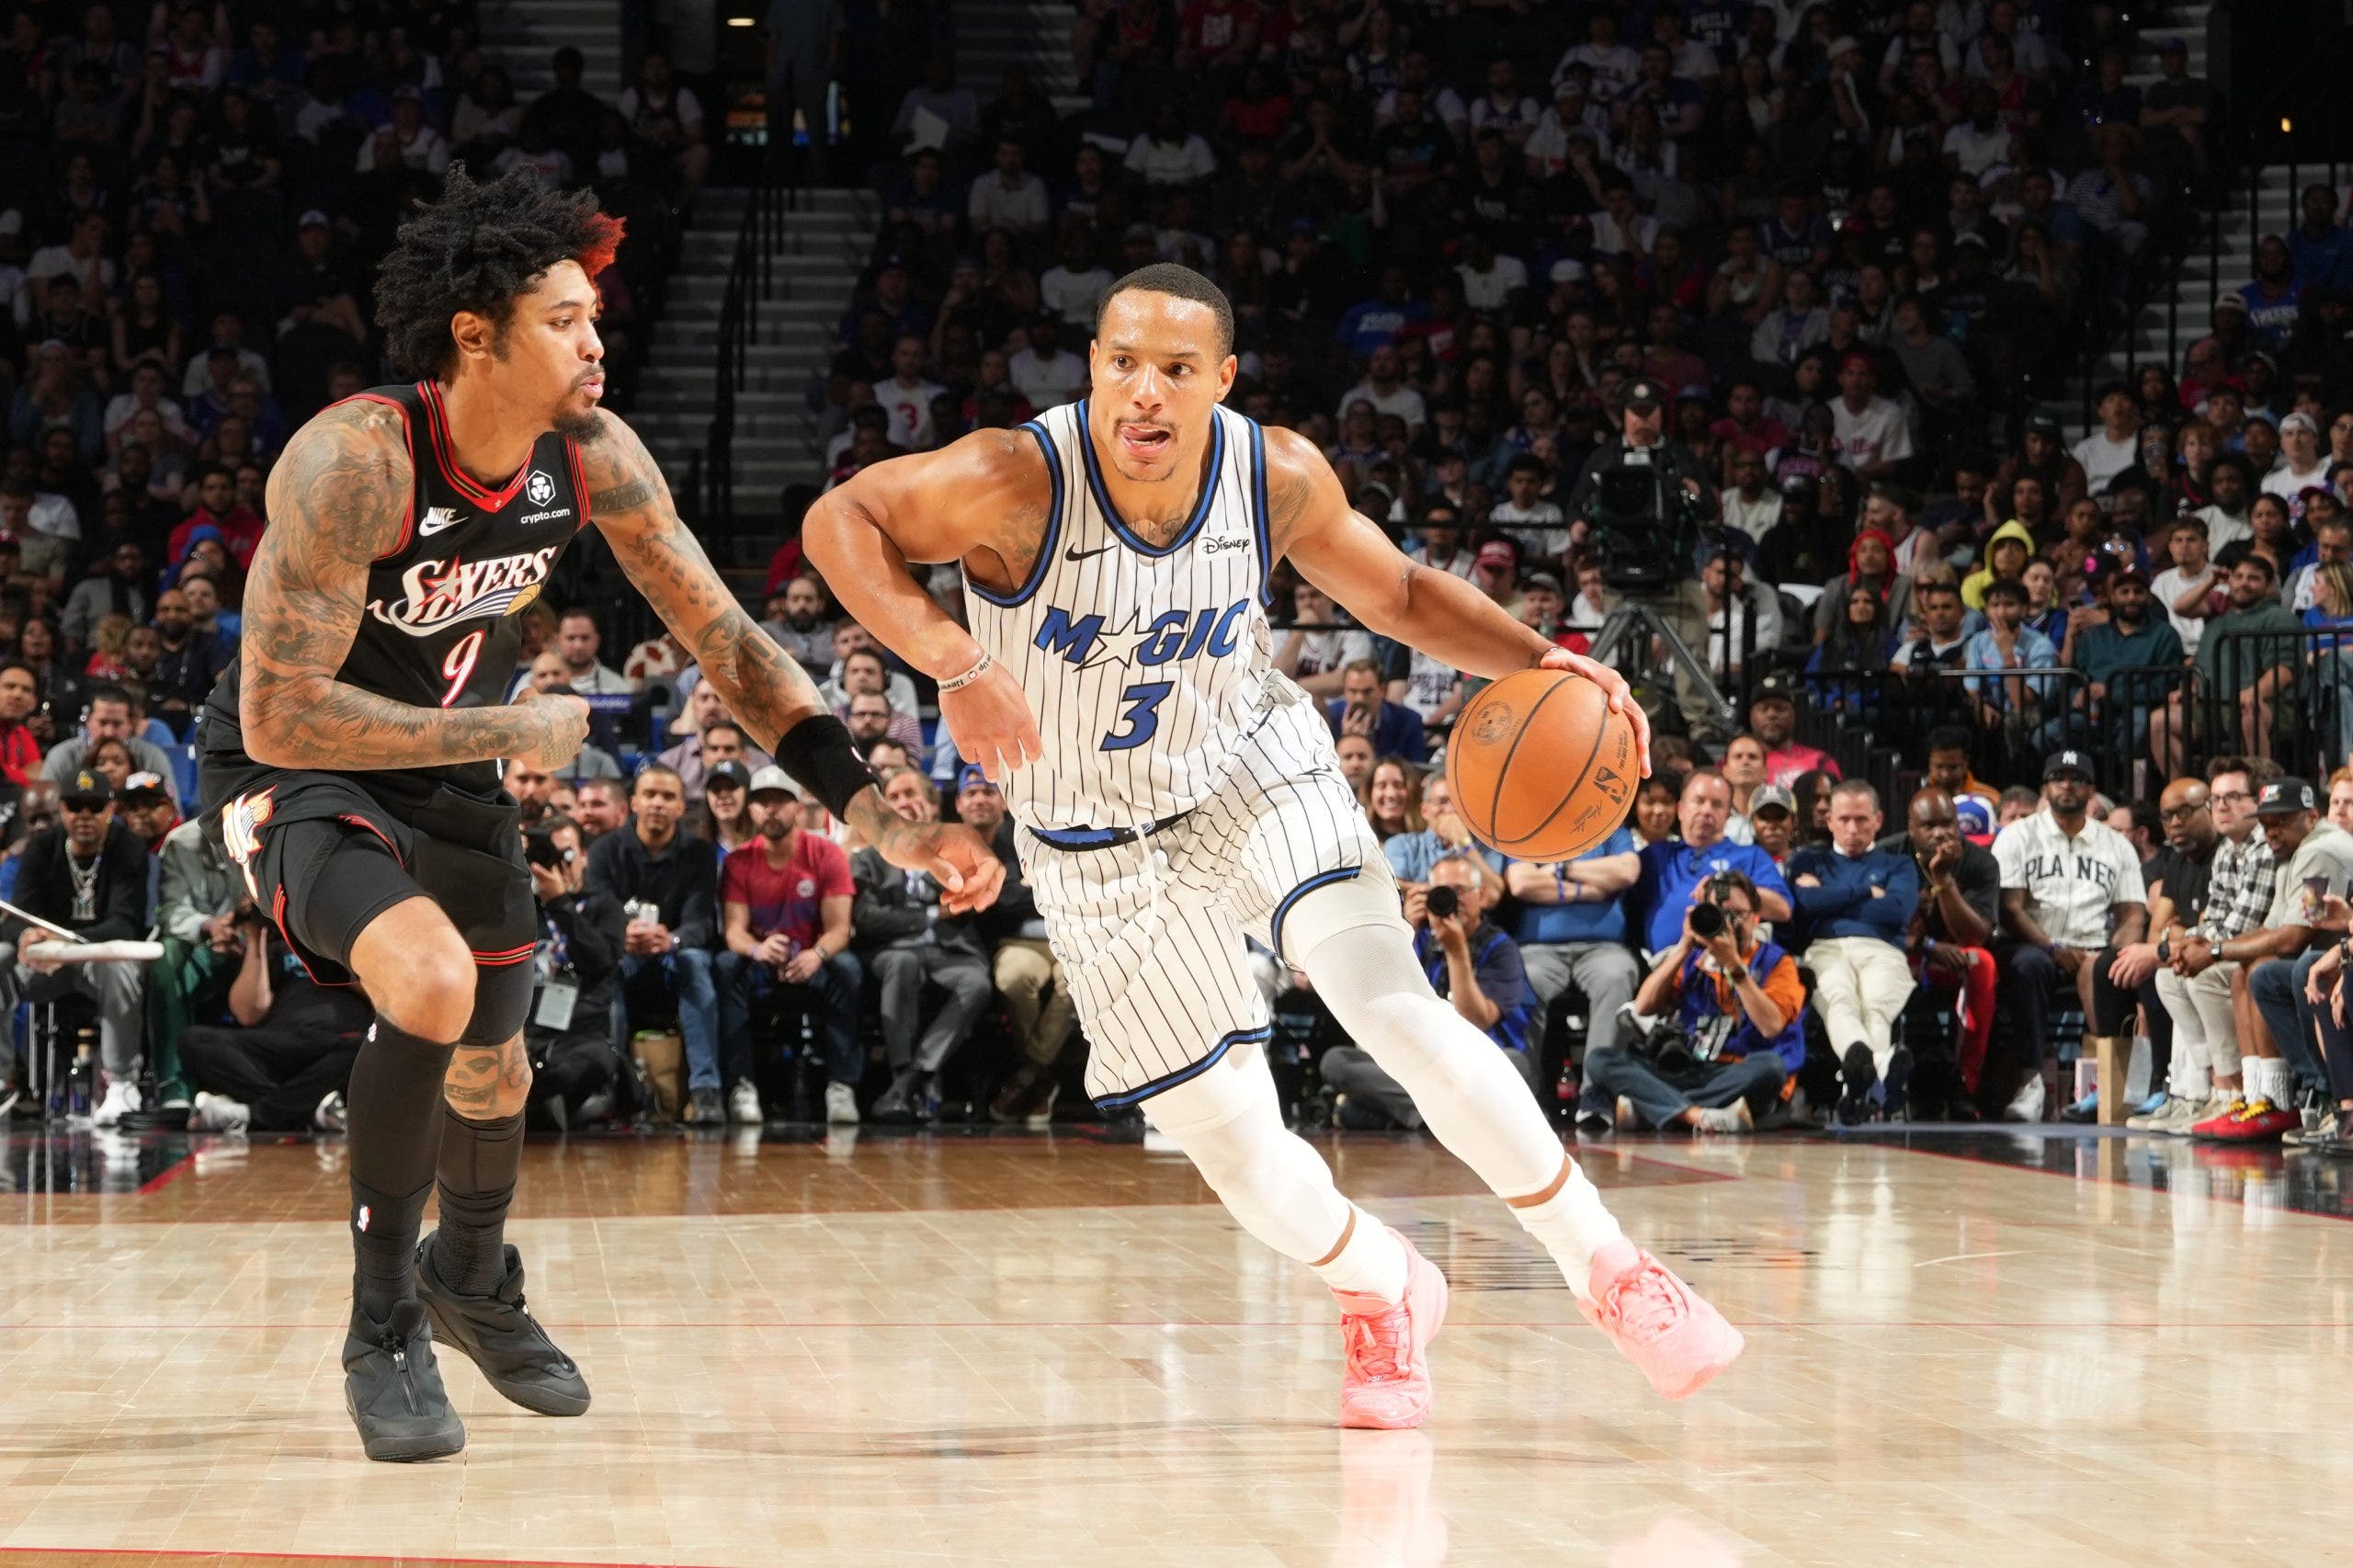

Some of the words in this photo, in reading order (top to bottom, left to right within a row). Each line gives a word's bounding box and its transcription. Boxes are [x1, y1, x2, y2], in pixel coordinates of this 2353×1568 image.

[426, 506, 456, 524] NIKE
[520, 508, 571, 524] crypto.com
[441, 630, 485, 709] 9
[1098, 680, 1176, 752] 3
